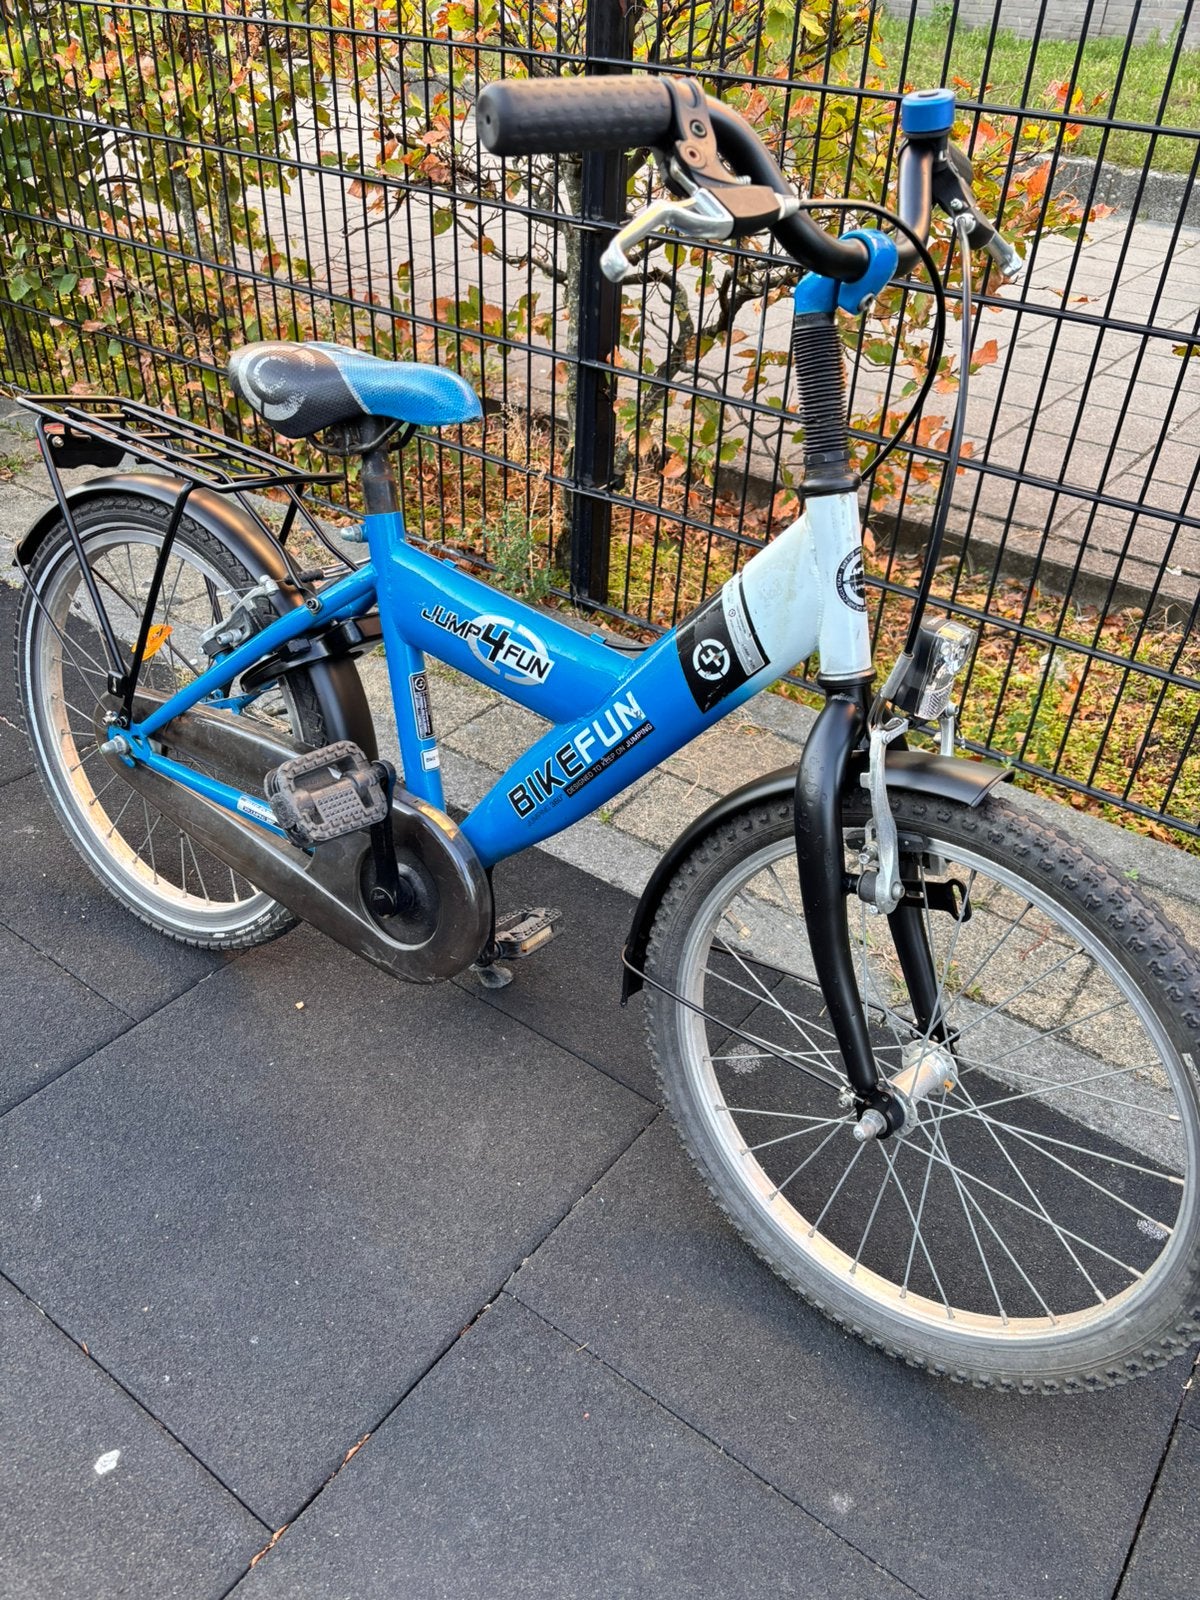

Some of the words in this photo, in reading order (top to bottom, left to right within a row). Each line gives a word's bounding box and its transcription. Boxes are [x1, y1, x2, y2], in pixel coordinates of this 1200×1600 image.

[566, 771, 594, 795] DESIGNED
[593, 764, 602, 773] TO
[601, 753, 616, 770] KEEP
[616, 744, 626, 755] ON
[625, 724, 654, 748] JUMPING
